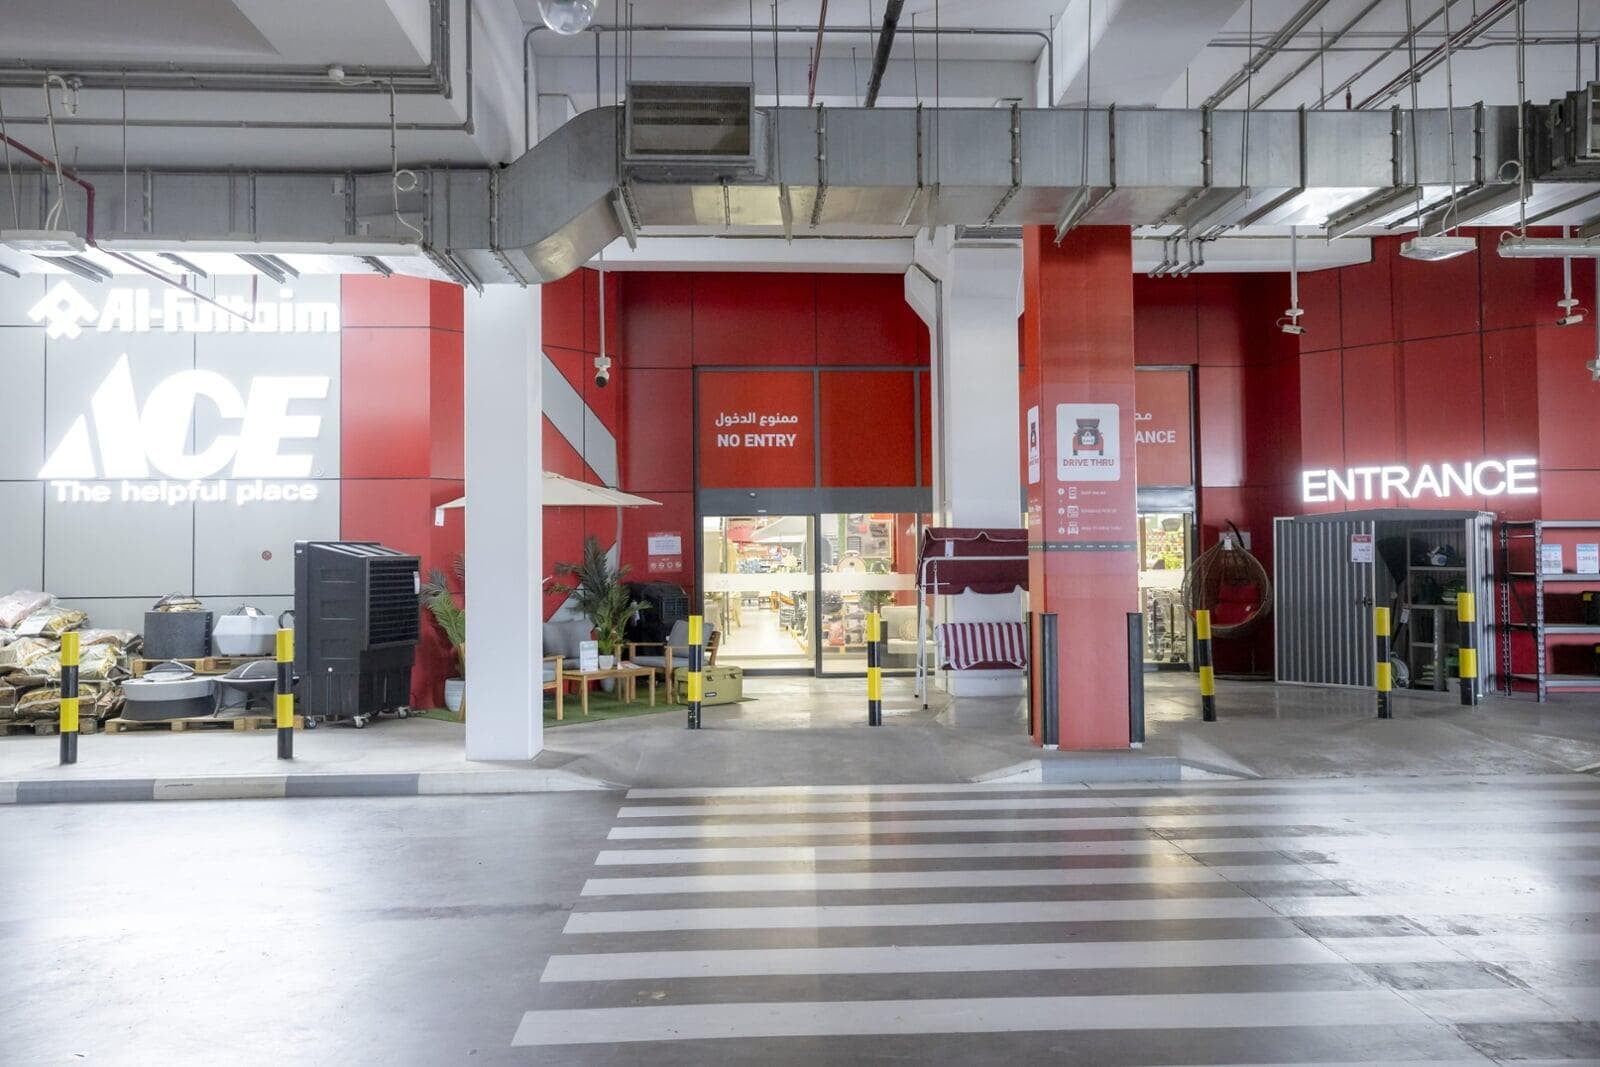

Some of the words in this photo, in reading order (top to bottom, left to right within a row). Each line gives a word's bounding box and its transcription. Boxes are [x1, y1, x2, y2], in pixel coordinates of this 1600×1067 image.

[37, 352, 330, 479] ACE
[715, 412, 756, 427] الدخول
[759, 412, 799, 426] ممنوع
[717, 434, 740, 447] NO
[744, 434, 797, 447] ENTRY
[1063, 459, 1089, 467] DRIVE
[1090, 459, 1114, 467] THRU
[1302, 458, 1538, 503] ENTRANCE
[51, 480, 113, 502] The
[121, 480, 227, 505] helpful
[236, 480, 320, 505] place
